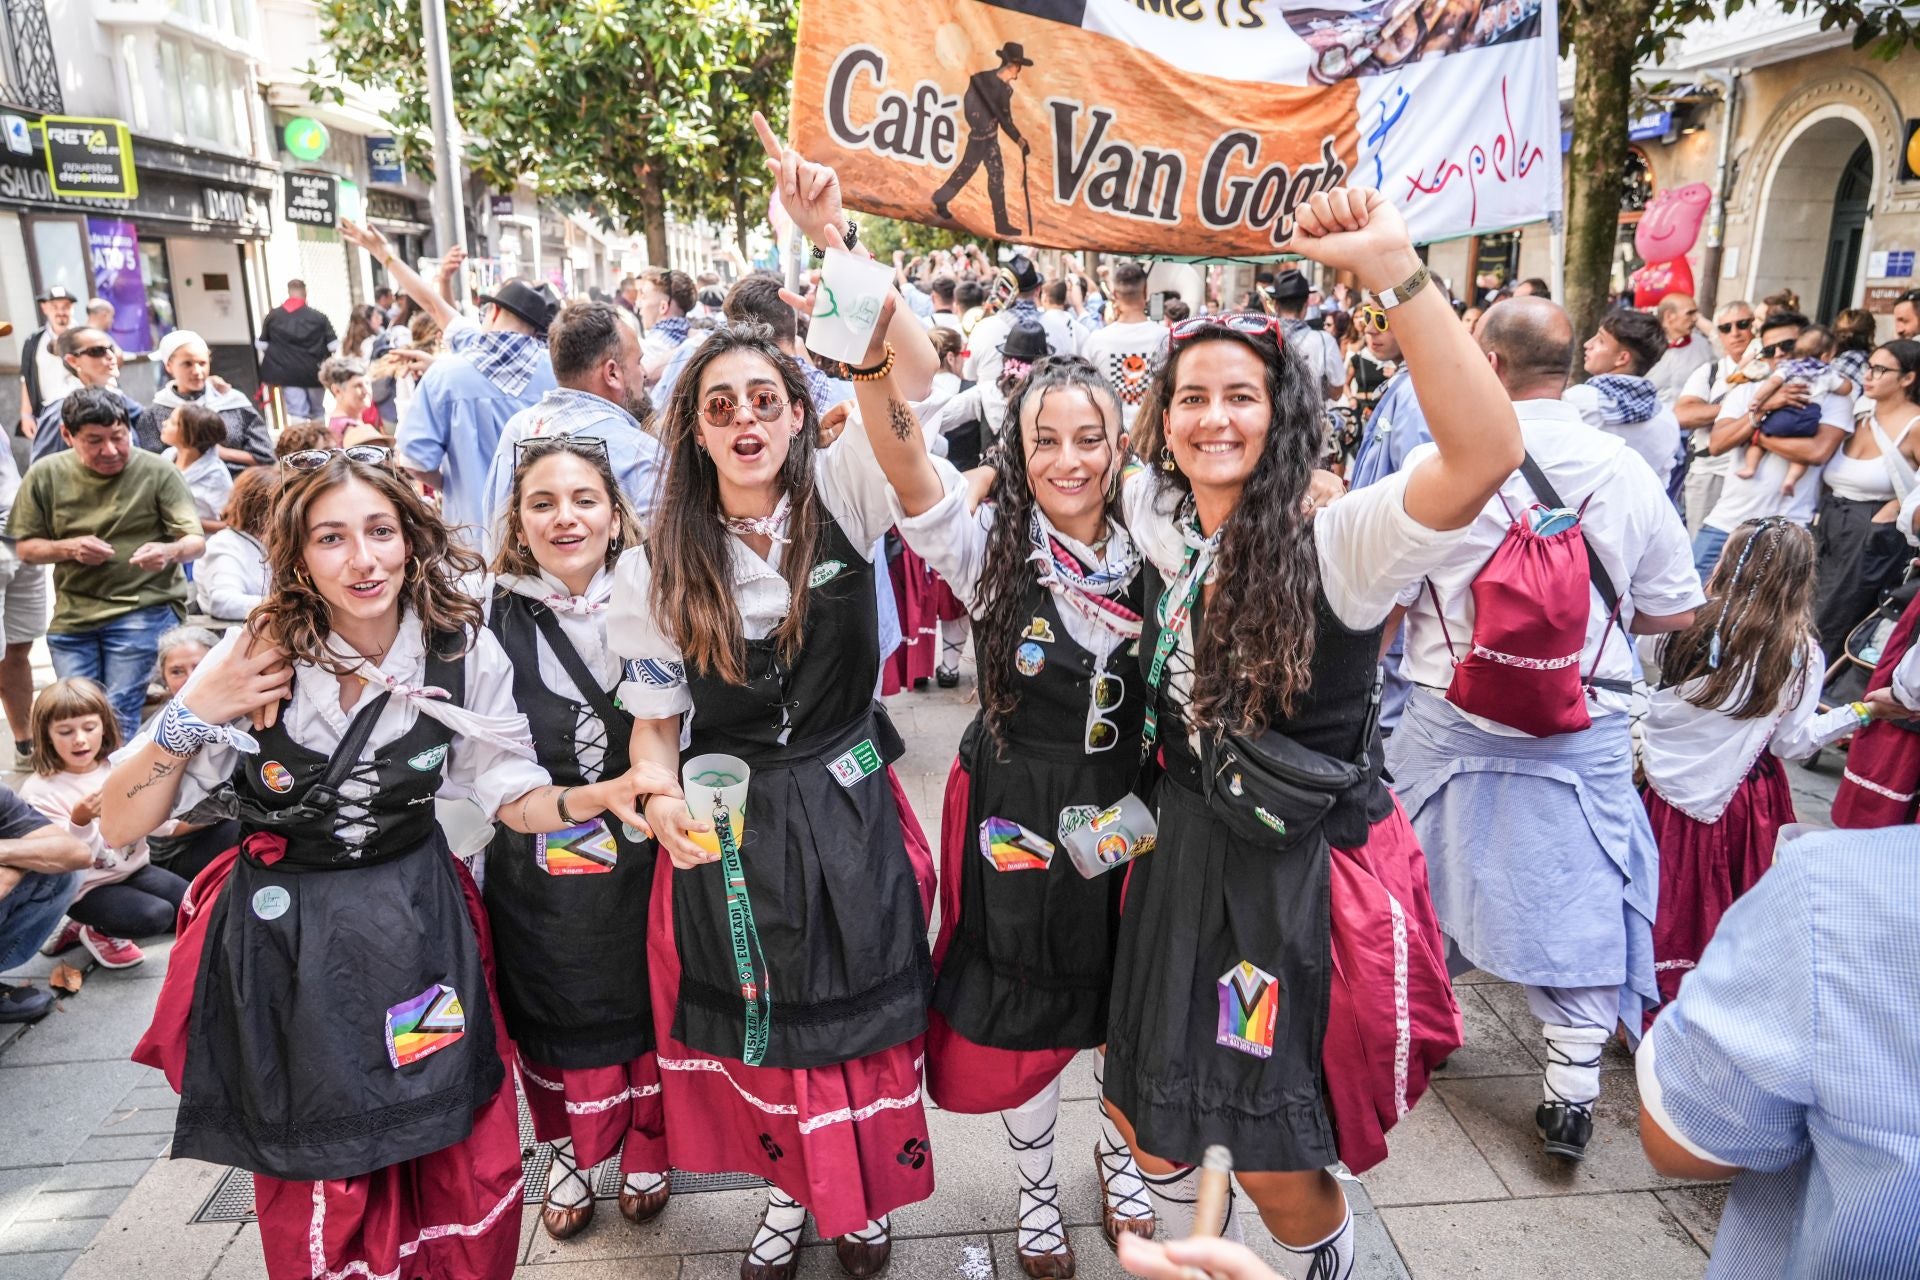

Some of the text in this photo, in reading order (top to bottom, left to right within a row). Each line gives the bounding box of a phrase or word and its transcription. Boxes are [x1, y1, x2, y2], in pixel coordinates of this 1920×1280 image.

[48, 127, 107, 152] RETA
[828, 48, 958, 164] Café
[1049, 100, 1183, 221] Van
[62, 162, 113, 174] apuestas
[59, 171, 120, 185] deportivas
[287, 206, 322, 222] DATO
